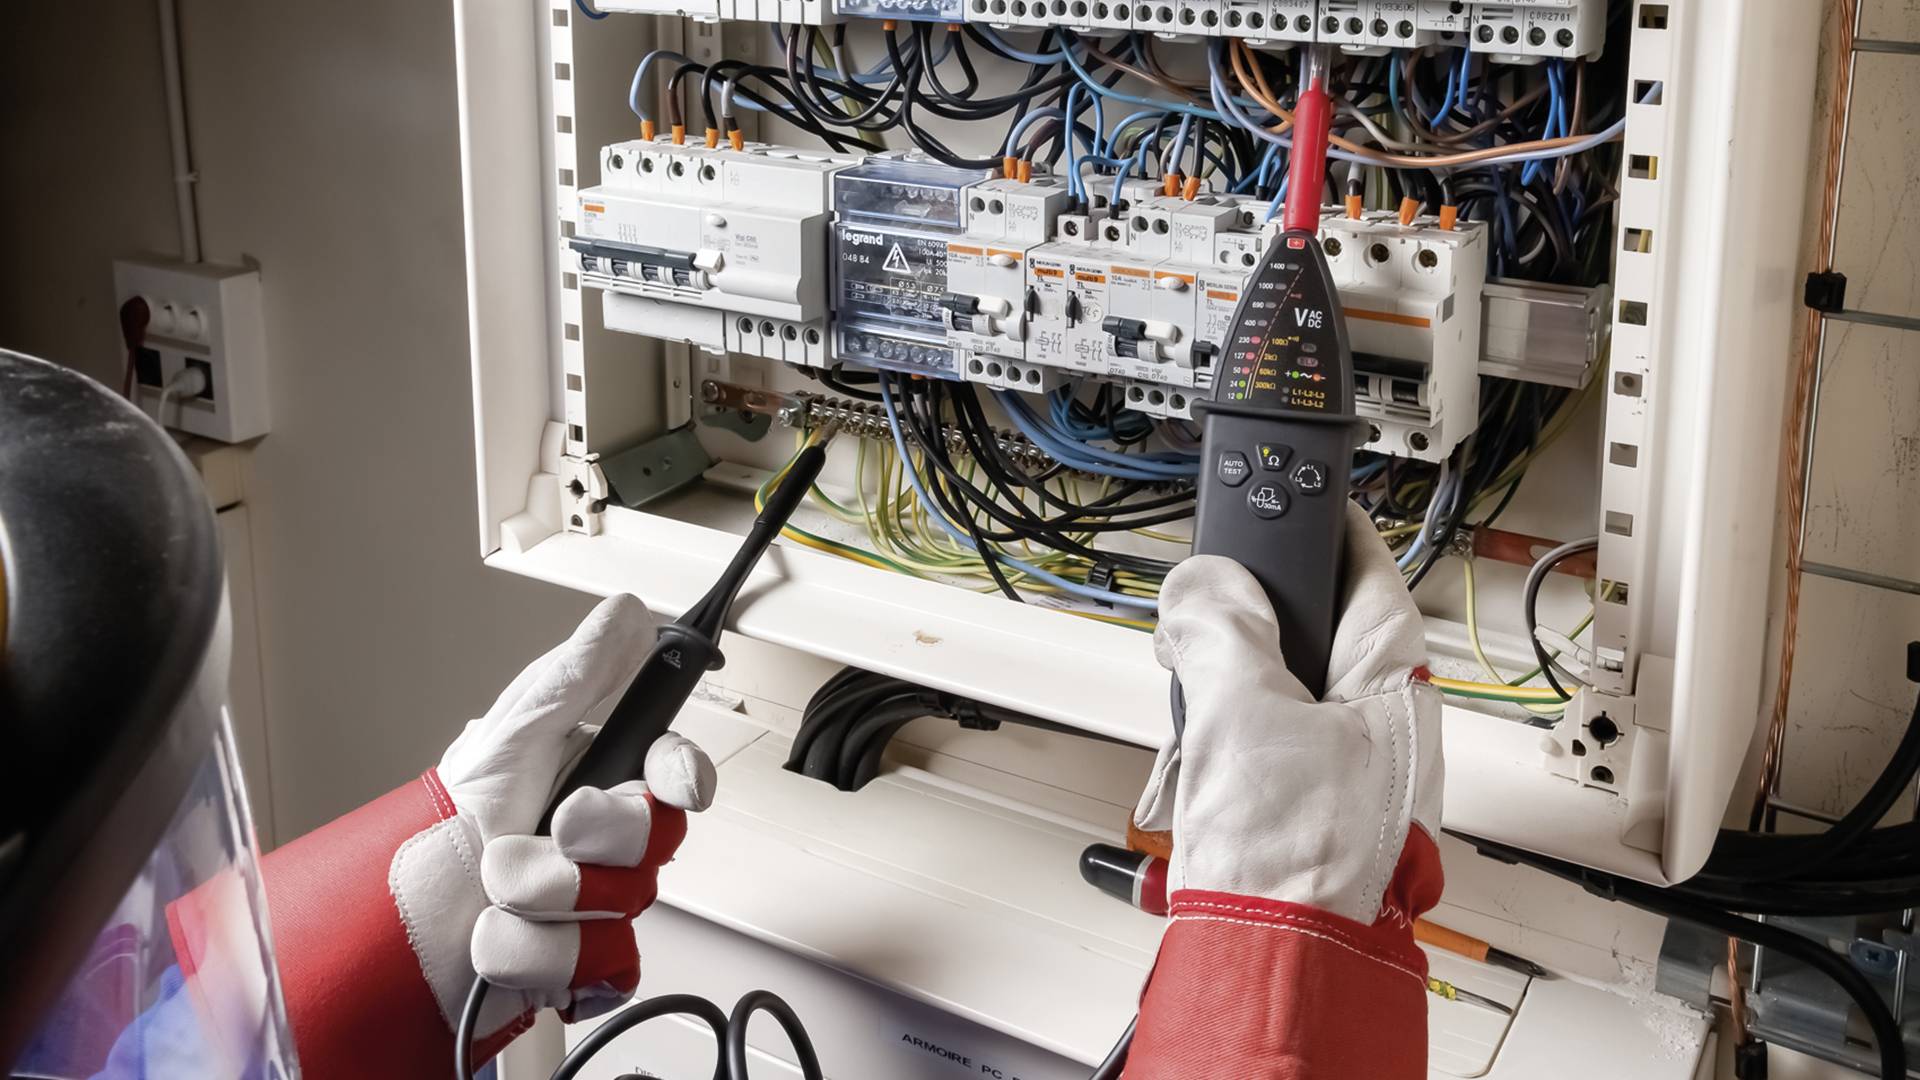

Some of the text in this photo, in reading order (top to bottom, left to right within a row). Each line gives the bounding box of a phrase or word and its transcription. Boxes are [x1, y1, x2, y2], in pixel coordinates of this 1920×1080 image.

[842, 228, 884, 246] legrand
[842, 252, 870, 264] 048 84
[1269, 262, 1286, 270] 1400
[1258, 282, 1274, 290] 1000
[1251, 301, 1265, 309] 690
[1294, 307, 1309, 327] V
[1309, 310, 1323, 320] AC
[1307, 318, 1322, 329] DC
[1238, 336, 1250, 344] 230
[1234, 352, 1245, 360] 127
[1233, 366, 1241, 374] 50
[1229, 380, 1238, 388] 24
[1227, 392, 1236, 400] 12
[1292, 387, 1325, 399] L1-L2-L3
[1291, 397, 1324, 409] L1-L3-L2
[1223, 460, 1244, 468] AUTO
[1263, 502, 1282, 511] 30mA
[902, 1034, 1003, 1080] ARMOIRE PC
